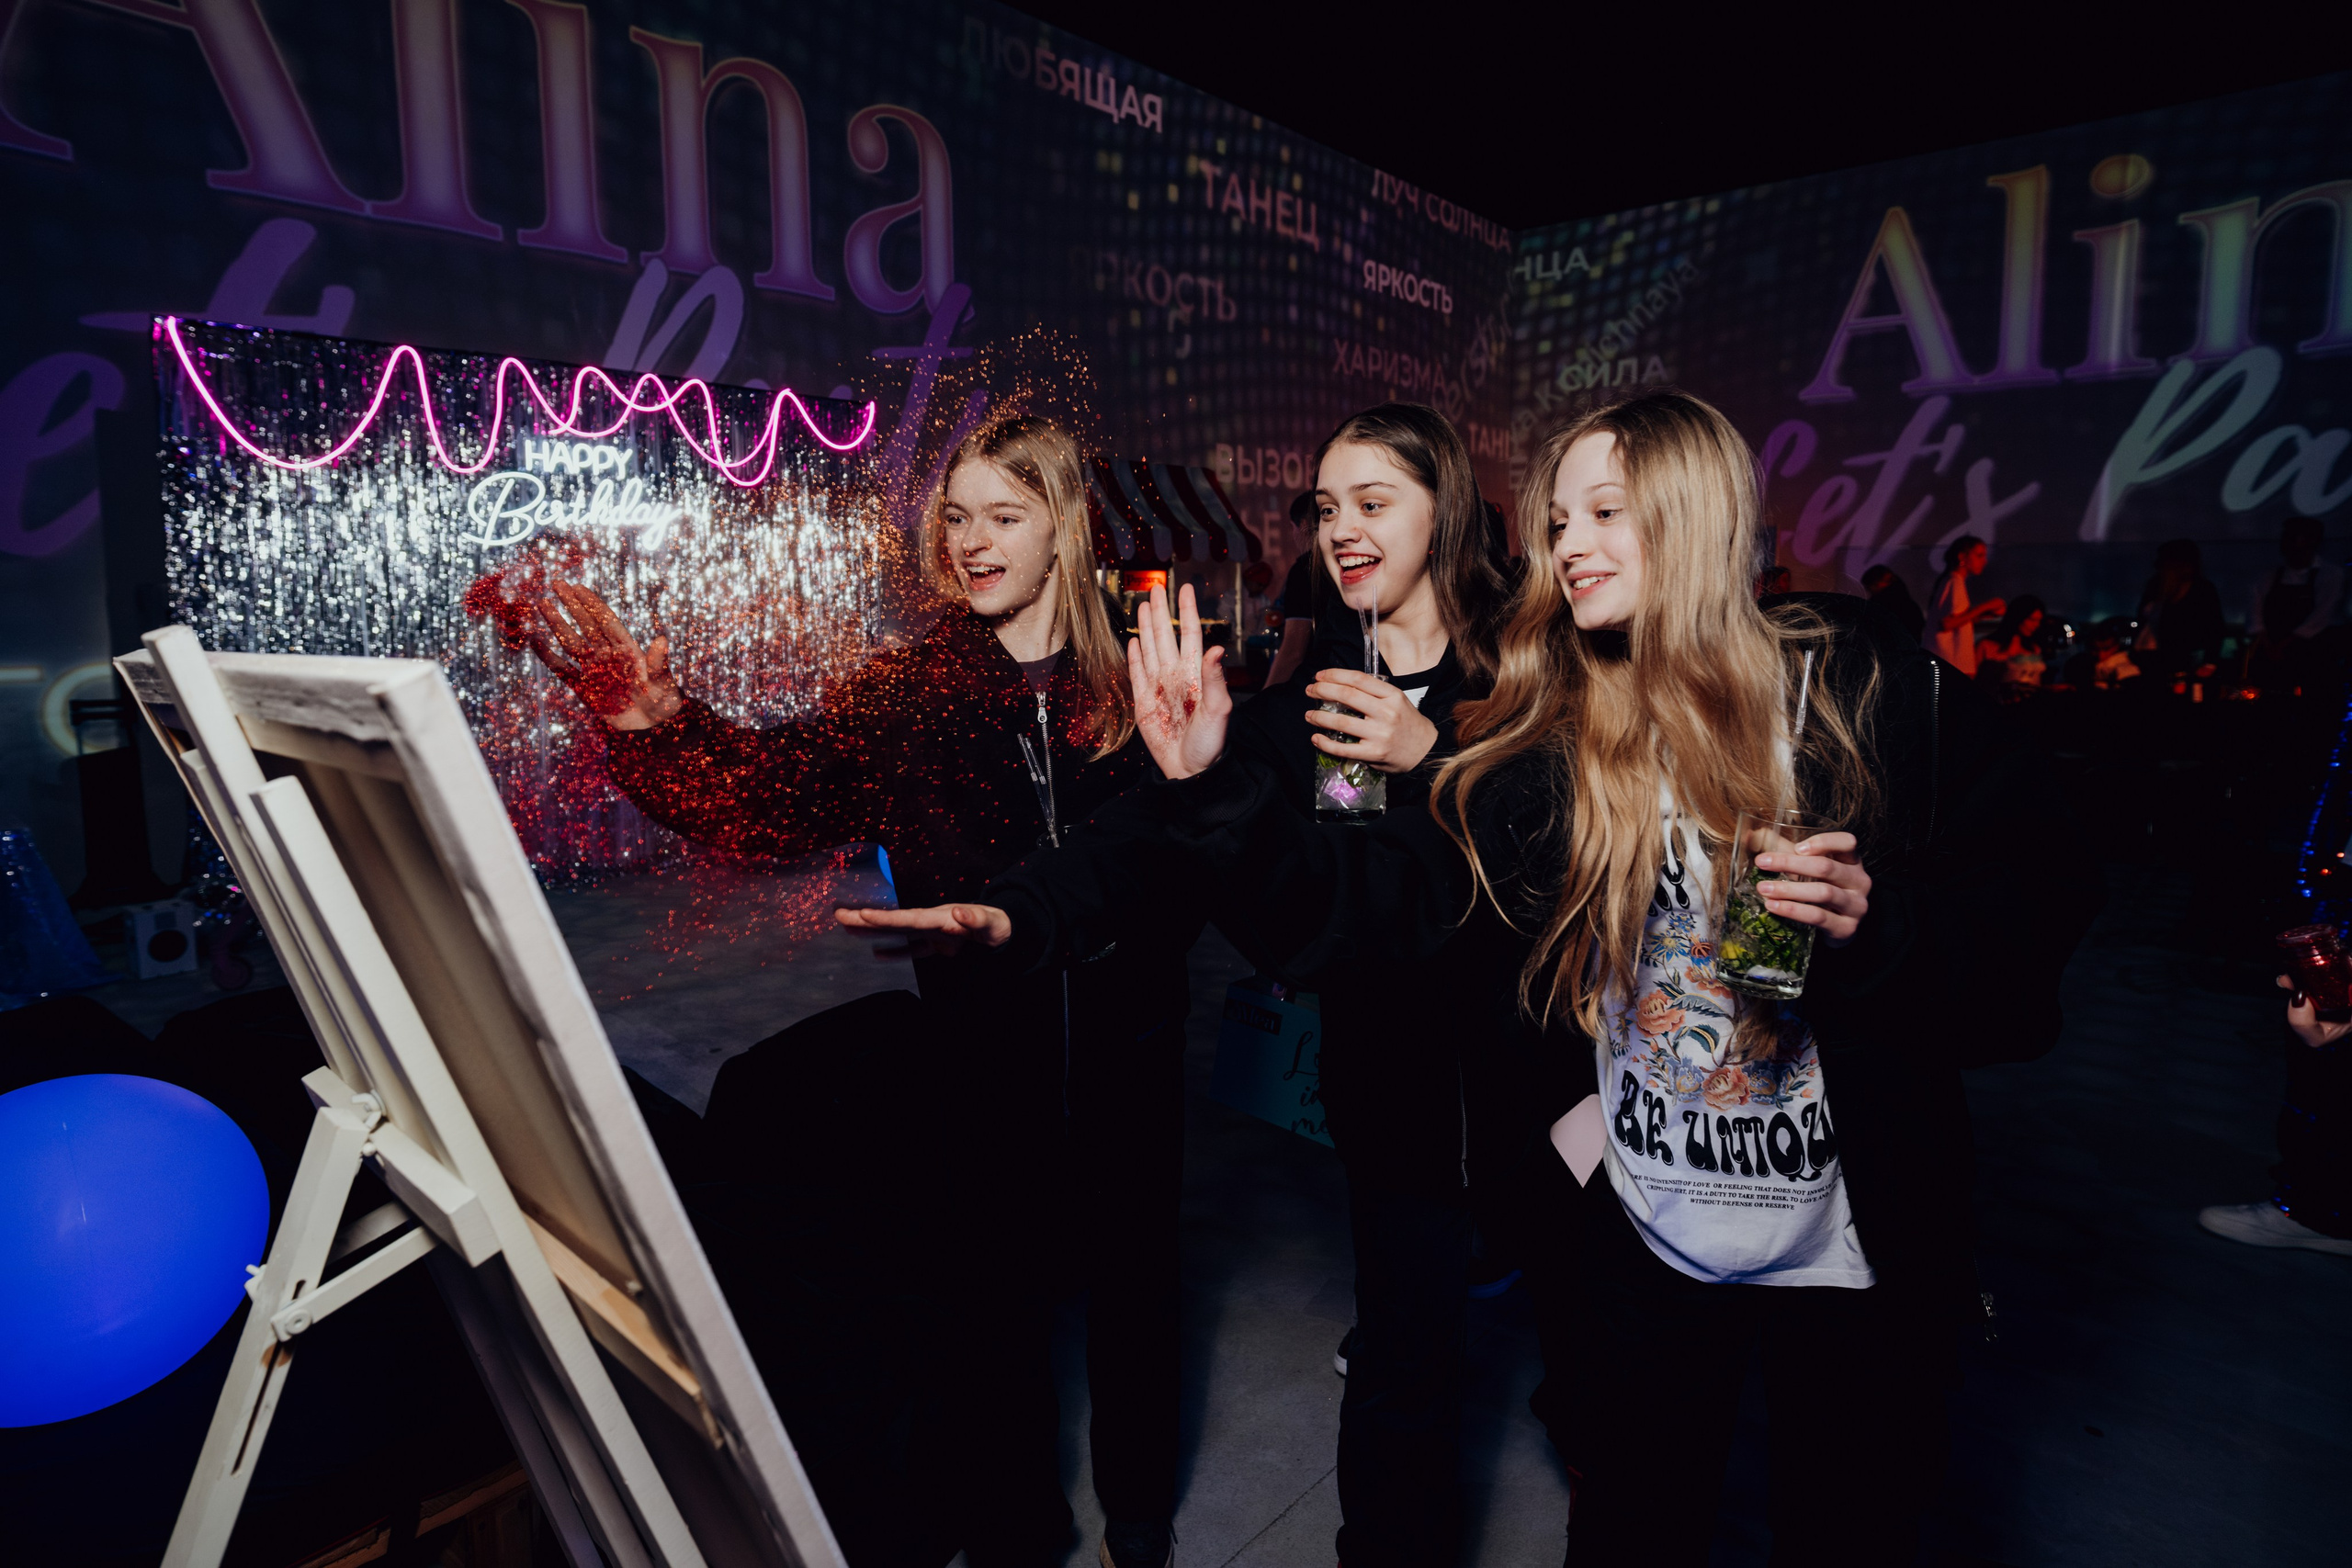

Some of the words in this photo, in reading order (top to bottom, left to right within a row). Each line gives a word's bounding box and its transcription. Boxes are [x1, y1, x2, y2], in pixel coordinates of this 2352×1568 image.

[961, 16, 1164, 134] ЛЮБЯЩАЯ
[1199, 158, 1320, 254] ТАНЕЦ
[1363, 258, 1453, 315] ЯРКОСТЬ
[1333, 337, 1448, 397] ХАРИЗМА
[1558, 355, 1669, 393] СИЛА
[525, 439, 633, 479] HAPPY
[461, 471, 684, 551] Birthday
[1614, 1069, 1674, 1167] BE
[1690, 1198, 1721, 1206] WITHOUT
